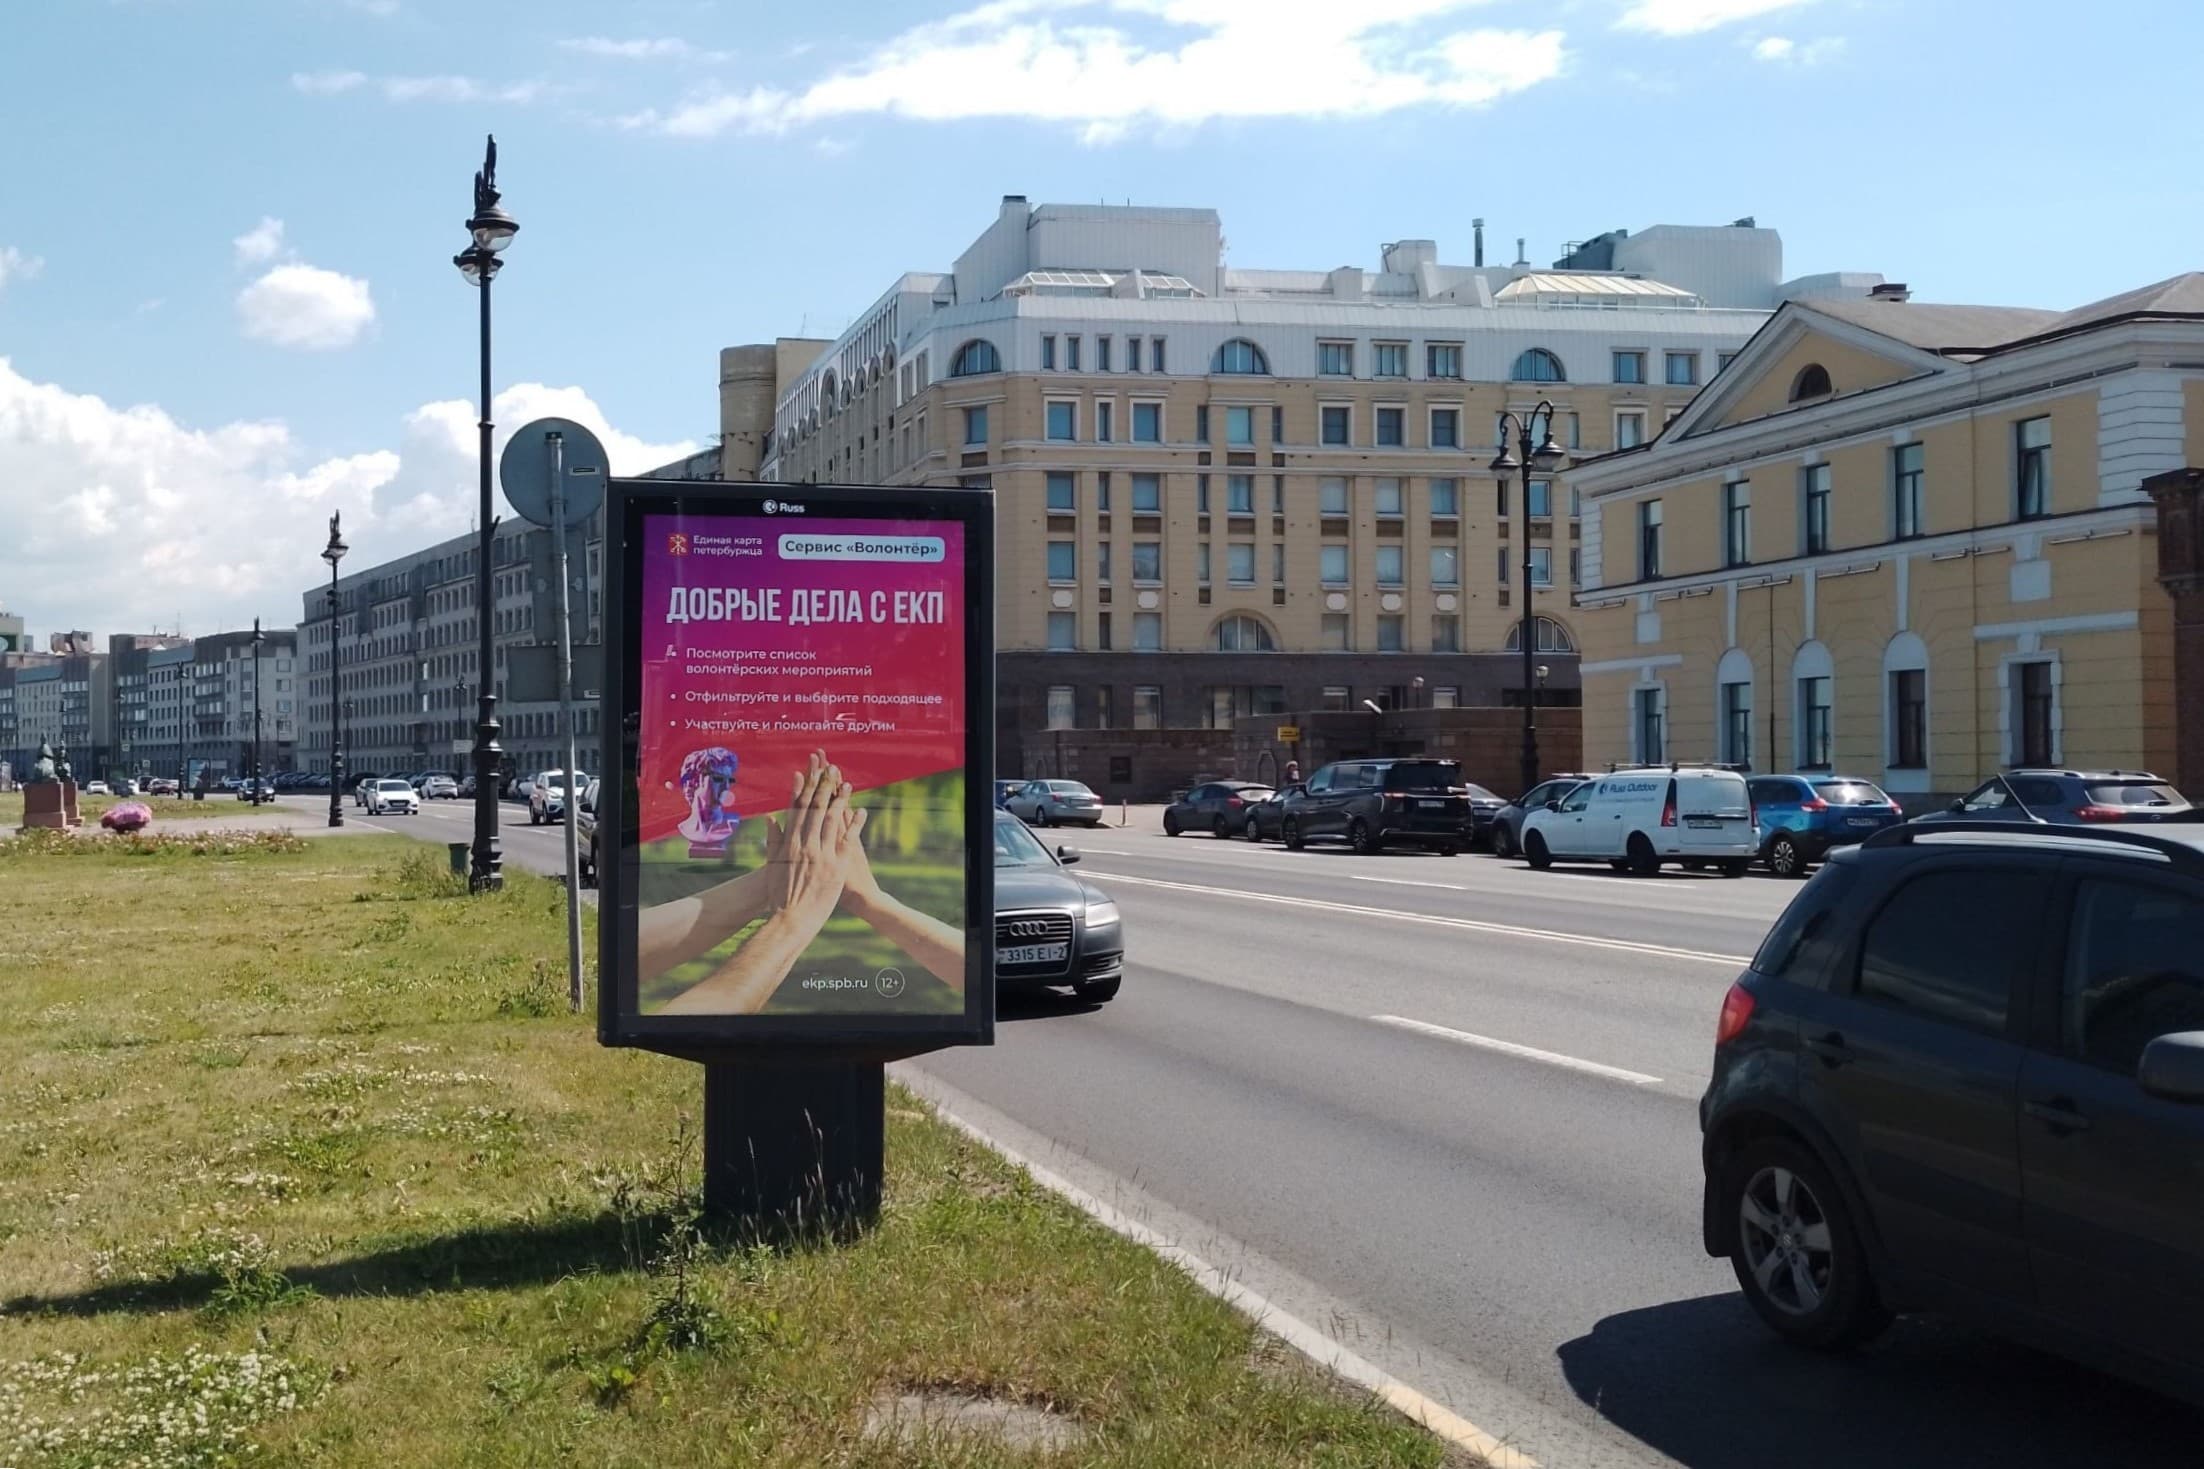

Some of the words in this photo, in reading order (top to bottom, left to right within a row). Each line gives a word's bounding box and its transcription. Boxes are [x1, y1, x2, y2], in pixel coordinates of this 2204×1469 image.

[779, 502, 805, 513] Russ
[693, 535, 732, 546] Единая
[734, 536, 763, 547] карта
[693, 546, 763, 557] петербуржца
[785, 540, 843, 555] Сервис
[846, 541, 938, 557] «Волонтёр»
[666, 587, 782, 624] ДОБРЫЕ
[788, 589, 863, 626] ДЕЛА
[869, 590, 886, 623] С
[893, 591, 943, 624] ЕКП
[686, 647, 767, 661] Посмотрите
[769, 650, 817, 661] список
[686, 663, 779, 676] волонтёрских
[782, 665, 873, 677] мероприятий
[685, 690, 779, 704] Отфильтруйте
[783, 694, 791, 702] и
[794, 691, 860, 704] выберите
[862, 693, 943, 705] подходящее
[685, 719, 760, 732] Участвуйте
[762, 721, 771, 730] и
[774, 719, 845, 732] помогайте
[847, 722, 896, 734] другим
[1007, 948, 1034, 961] 3315
[802, 977, 868, 991] ekp.spb.ru
[881, 977, 899, 988] 12+
